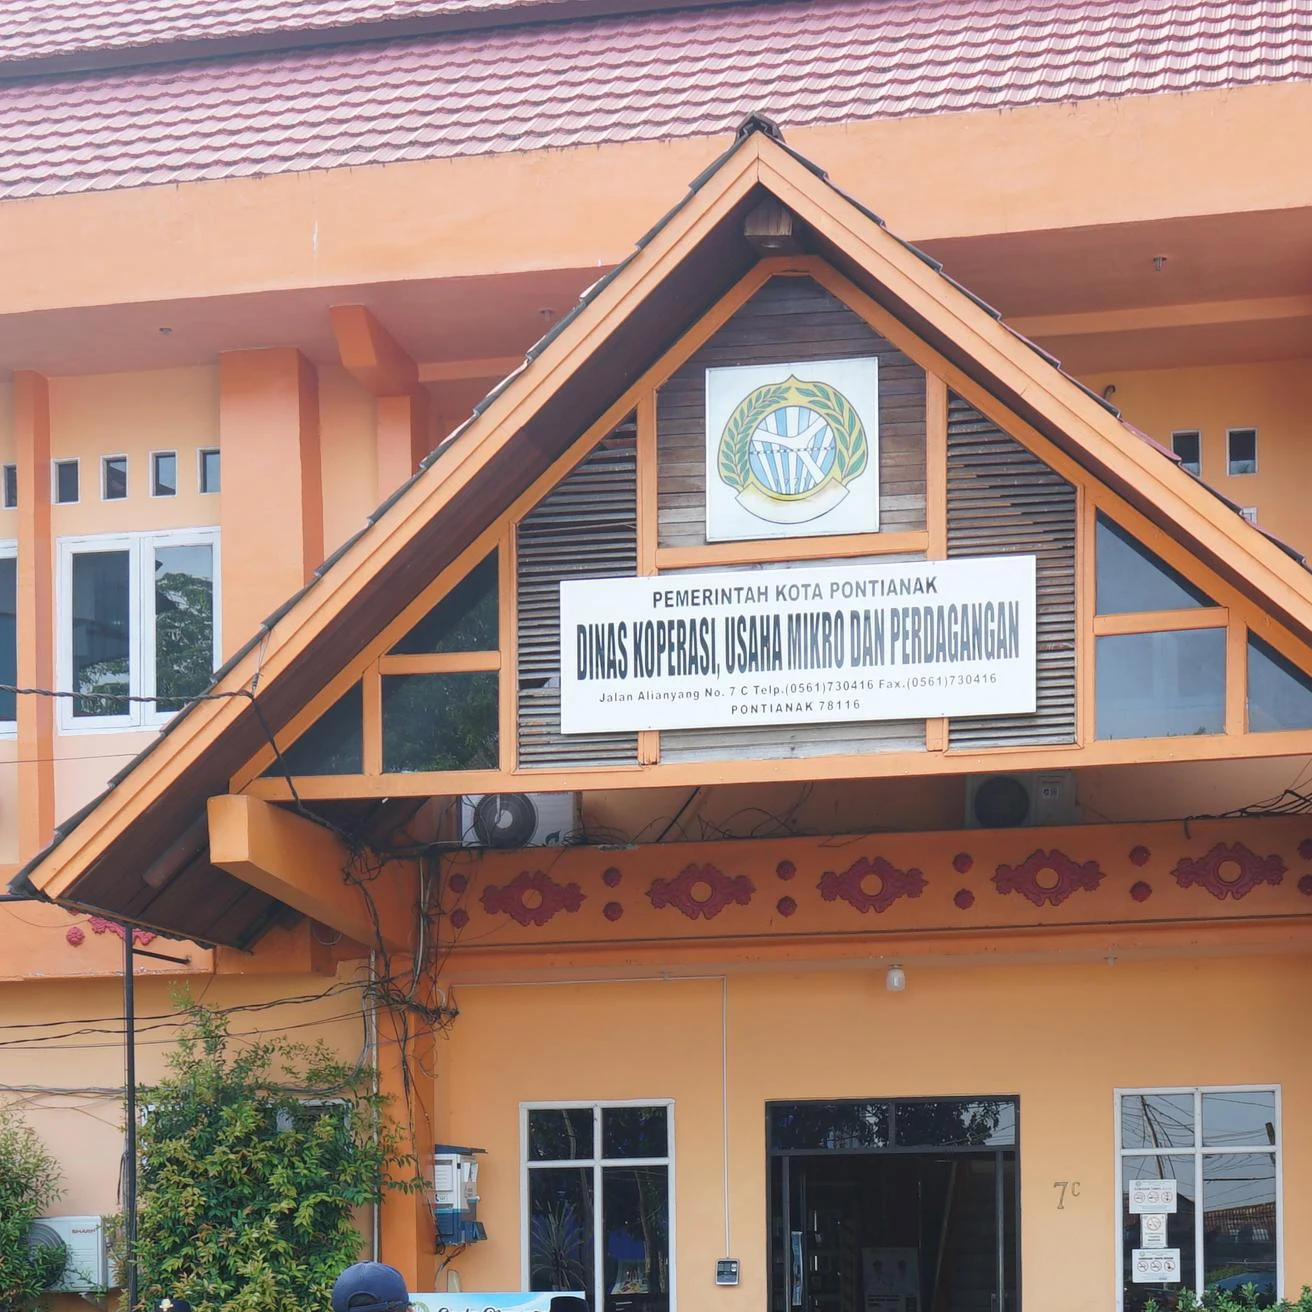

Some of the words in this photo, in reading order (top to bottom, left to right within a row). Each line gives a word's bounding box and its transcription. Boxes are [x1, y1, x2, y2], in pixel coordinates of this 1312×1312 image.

[653, 586, 768, 608] PEMERINTAH
[776, 583, 823, 602] KOTA
[830, 576, 938, 599] PONTIANAK
[576, 621, 628, 680] DINAS
[633, 617, 720, 679] KOPERASI,
[725, 614, 782, 674] USAHA
[788, 610, 844, 670] MIKRO
[850, 608, 885, 667] DAN
[890, 600, 1019, 666] PERDAGANGAN
[600, 693, 633, 703] Jalan
[638, 689, 700, 702] Alianyang
[705, 687, 724, 698] No.
[729, 687, 736, 697] 7
[741, 686, 748, 696] C
[879, 673, 997, 690] Fax.(0561)730416
[731, 701, 813, 715] PONTIANAK
[819, 700, 860, 711] 78116
